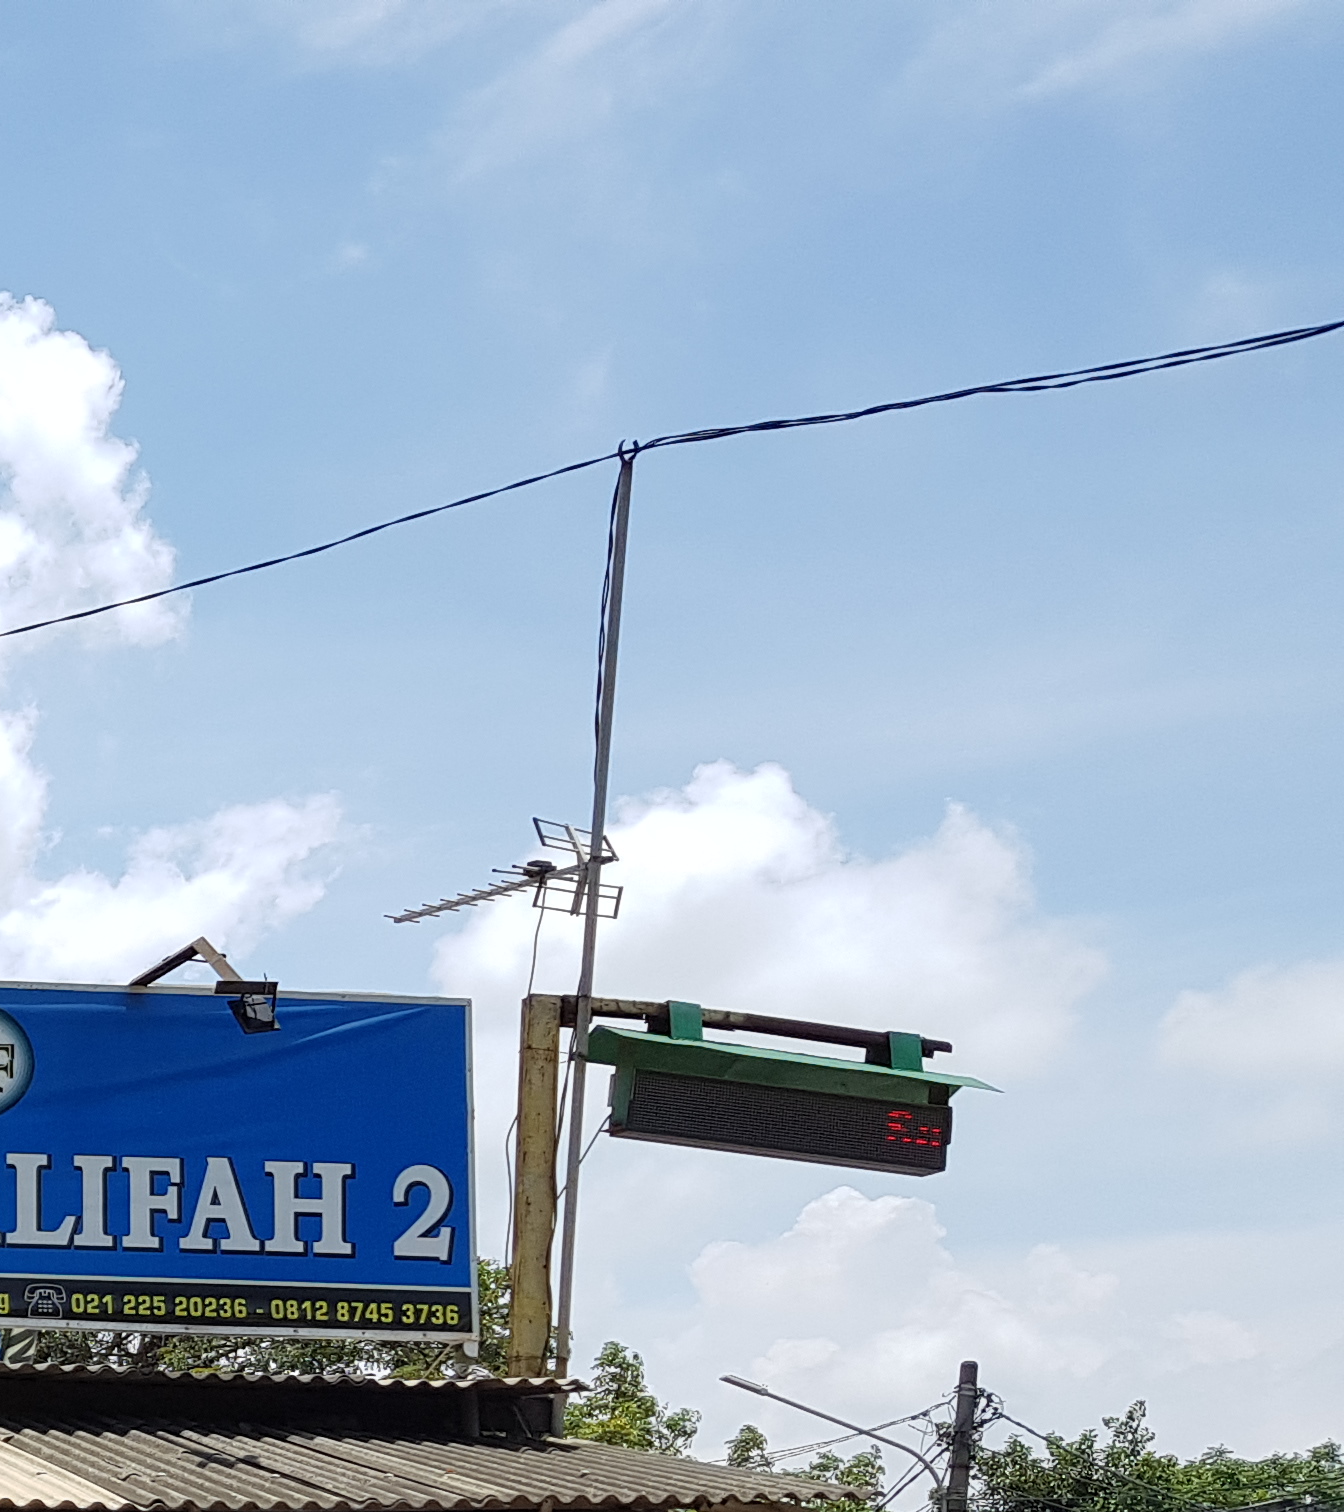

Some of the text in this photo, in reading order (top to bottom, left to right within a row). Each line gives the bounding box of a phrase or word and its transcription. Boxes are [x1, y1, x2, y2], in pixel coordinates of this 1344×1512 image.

[391, 1163, 457, 1264] 2
[70, 1292, 113, 1315] 021
[122, 1294, 165, 1317] 225
[174, 1296, 247, 1319] 20236
[270, 1299, 329, 1322] 0812
[336, 1301, 394, 1324] 8745
[401, 1303, 459, 1326] 3736
